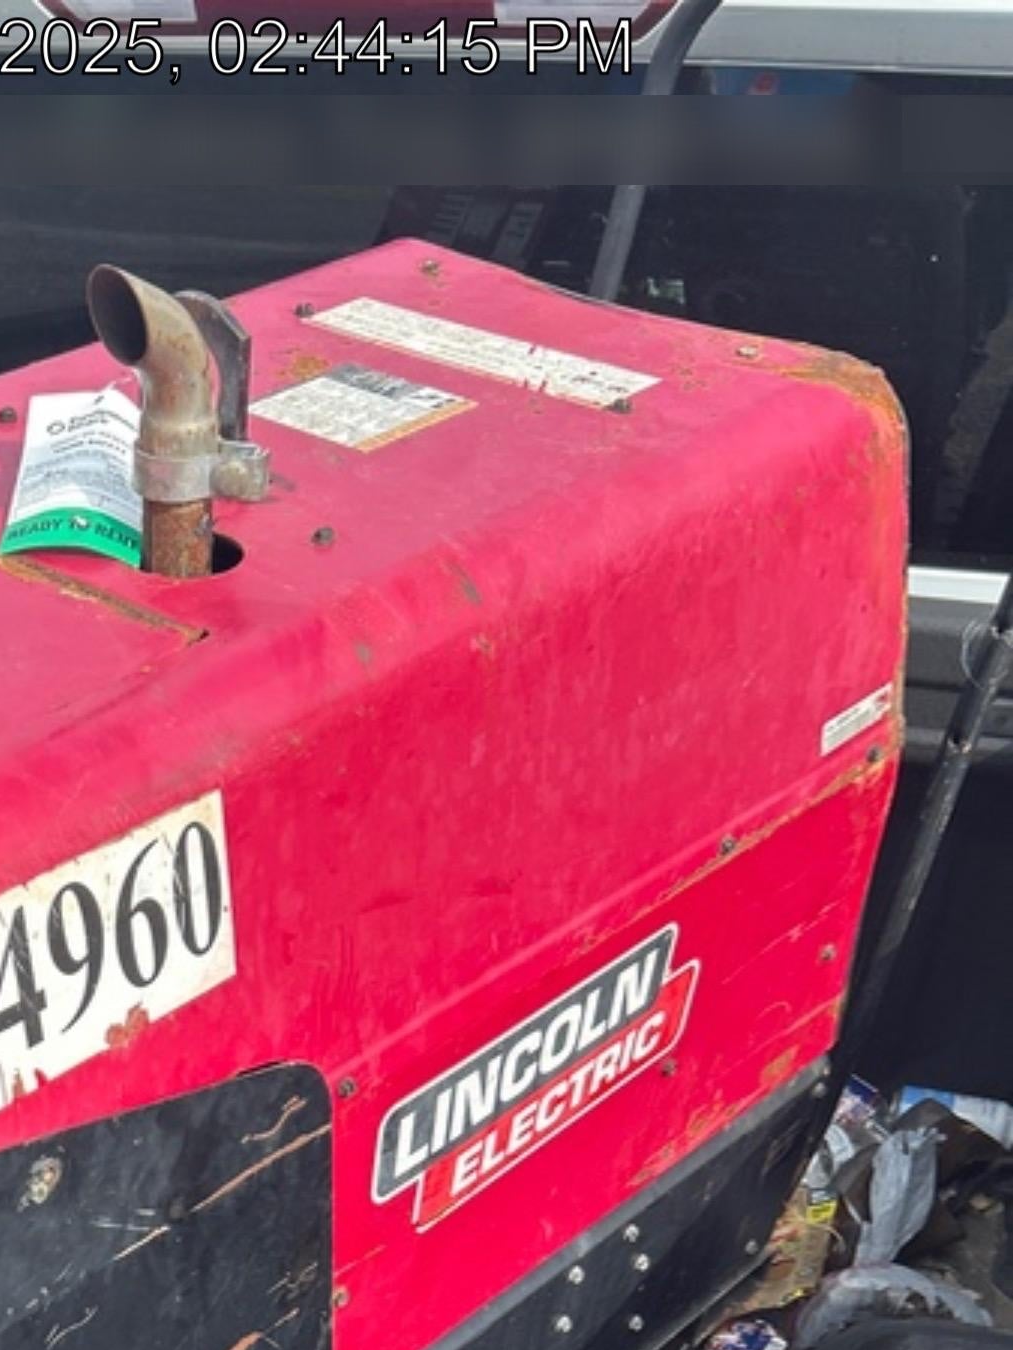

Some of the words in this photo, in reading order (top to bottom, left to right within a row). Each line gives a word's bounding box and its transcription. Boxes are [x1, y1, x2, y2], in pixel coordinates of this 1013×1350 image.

[6, 517, 63, 541] READY
[394, 948, 660, 1178] LINCOLN
[450, 1011, 666, 1198] ELECTRIC
